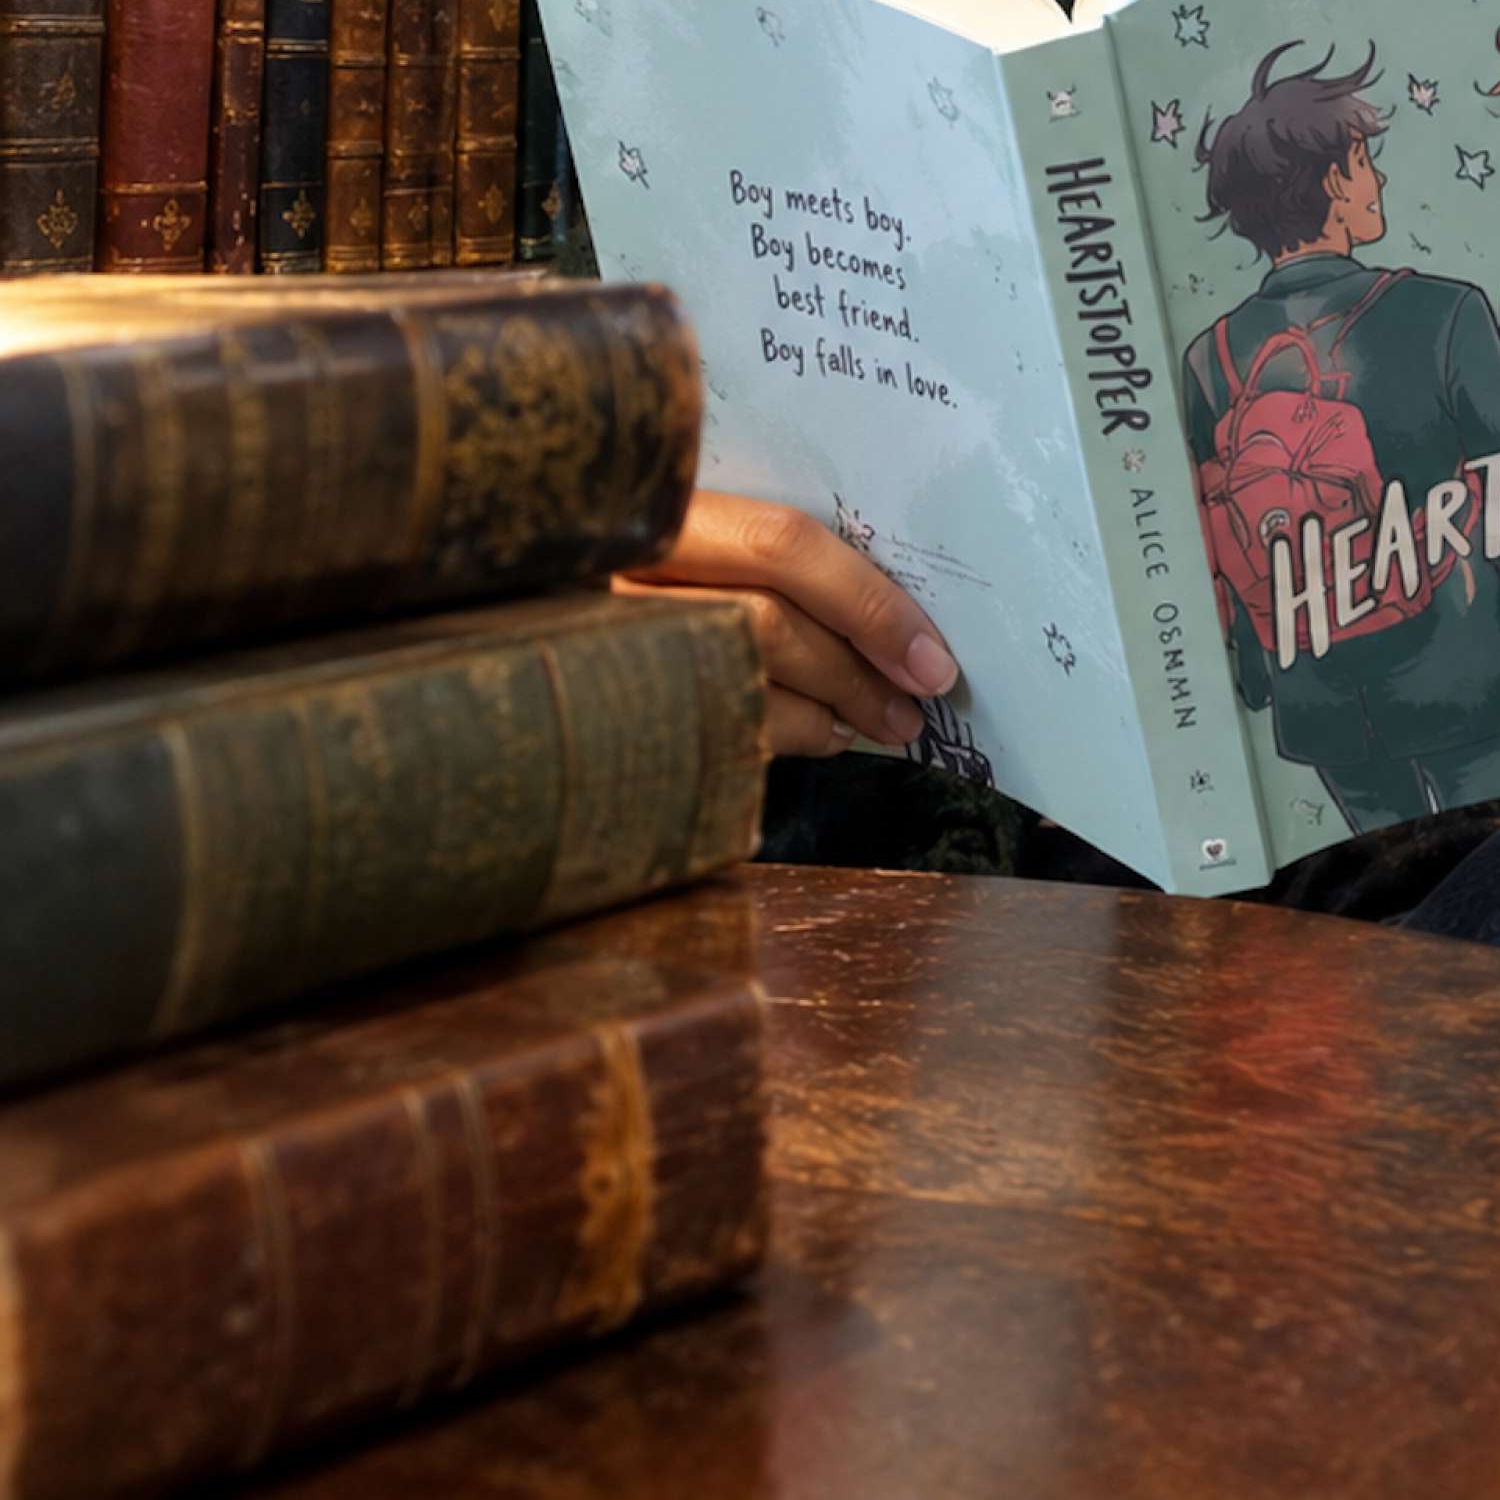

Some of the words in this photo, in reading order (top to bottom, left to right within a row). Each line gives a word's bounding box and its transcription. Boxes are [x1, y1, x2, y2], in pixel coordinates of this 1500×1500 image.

[730, 169, 773, 220] Boy
[785, 188, 854, 224] meets
[864, 196, 911, 251] boy.
[751, 224, 794, 272] Boy
[806, 232, 906, 290] becomes
[774, 274, 824, 318] best
[838, 289, 919, 343] friend.
[761, 327, 804, 376] Boy
[816, 337, 865, 380] falls
[874, 358, 897, 388] in
[906, 362, 958, 409] love.
[1045, 157, 1153, 436] HEARTSTOPPER
[1130, 487, 1170, 579] ALICE
